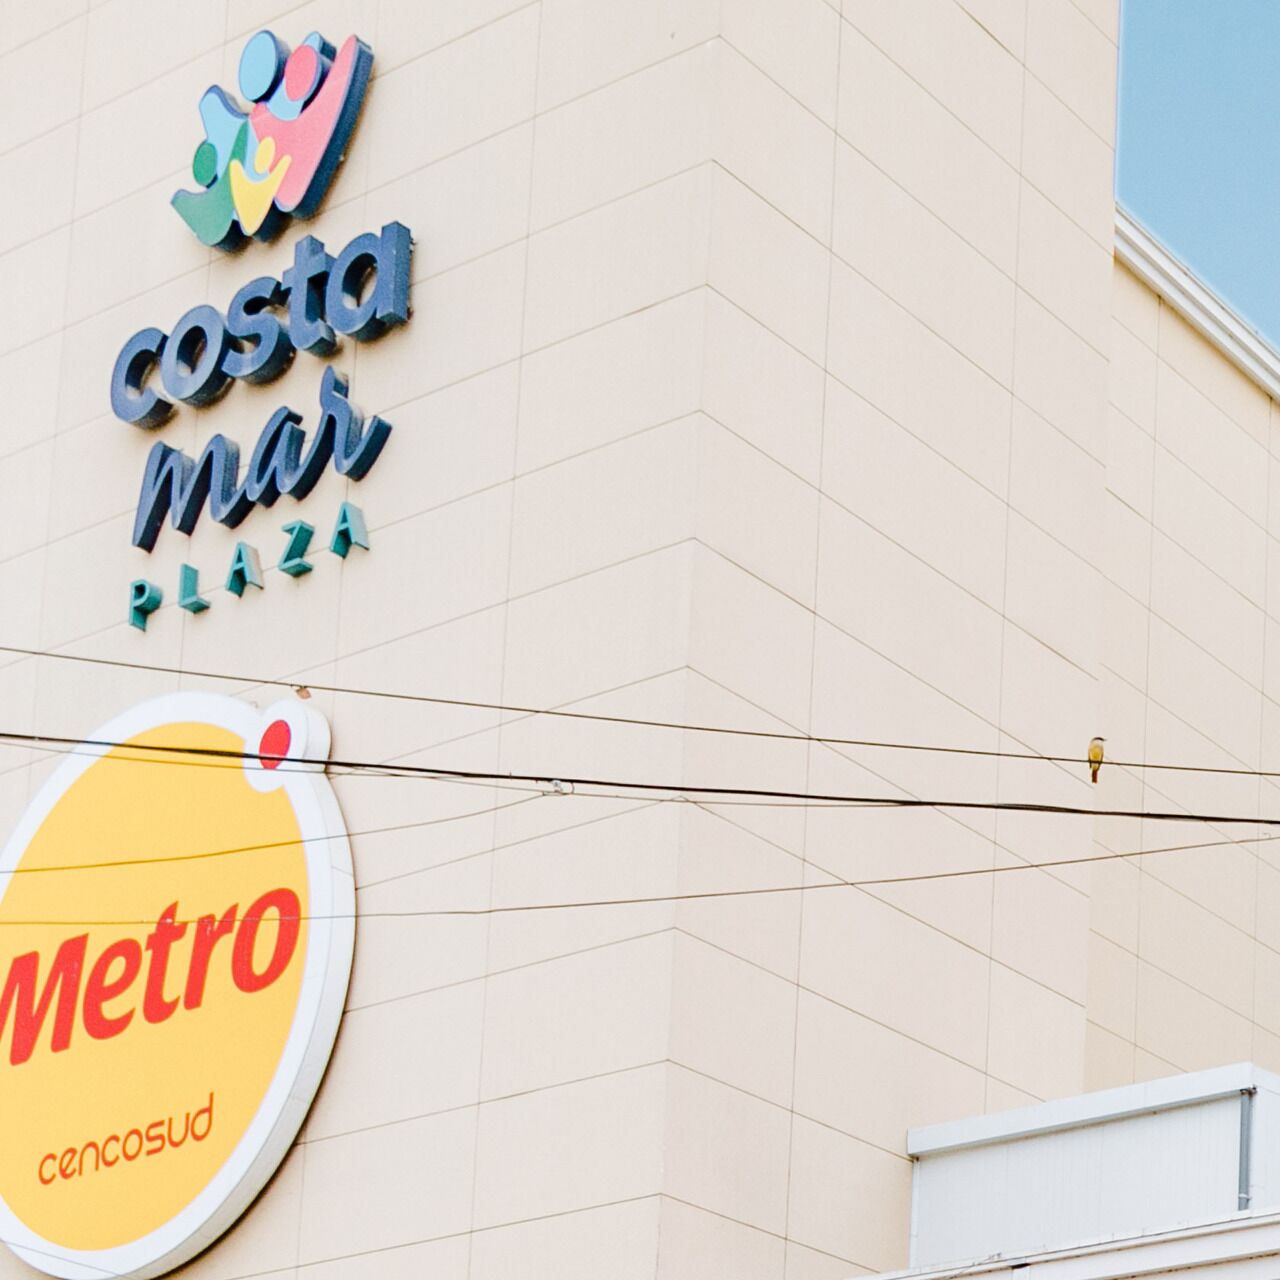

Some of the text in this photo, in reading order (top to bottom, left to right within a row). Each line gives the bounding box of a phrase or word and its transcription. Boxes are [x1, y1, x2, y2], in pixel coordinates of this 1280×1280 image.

[111, 220, 410, 429] costa
[133, 365, 392, 552] mar
[128, 502, 370, 632] PLAZA
[0, 887, 301, 1066] Metro
[38, 1092, 214, 1185] cencosud
